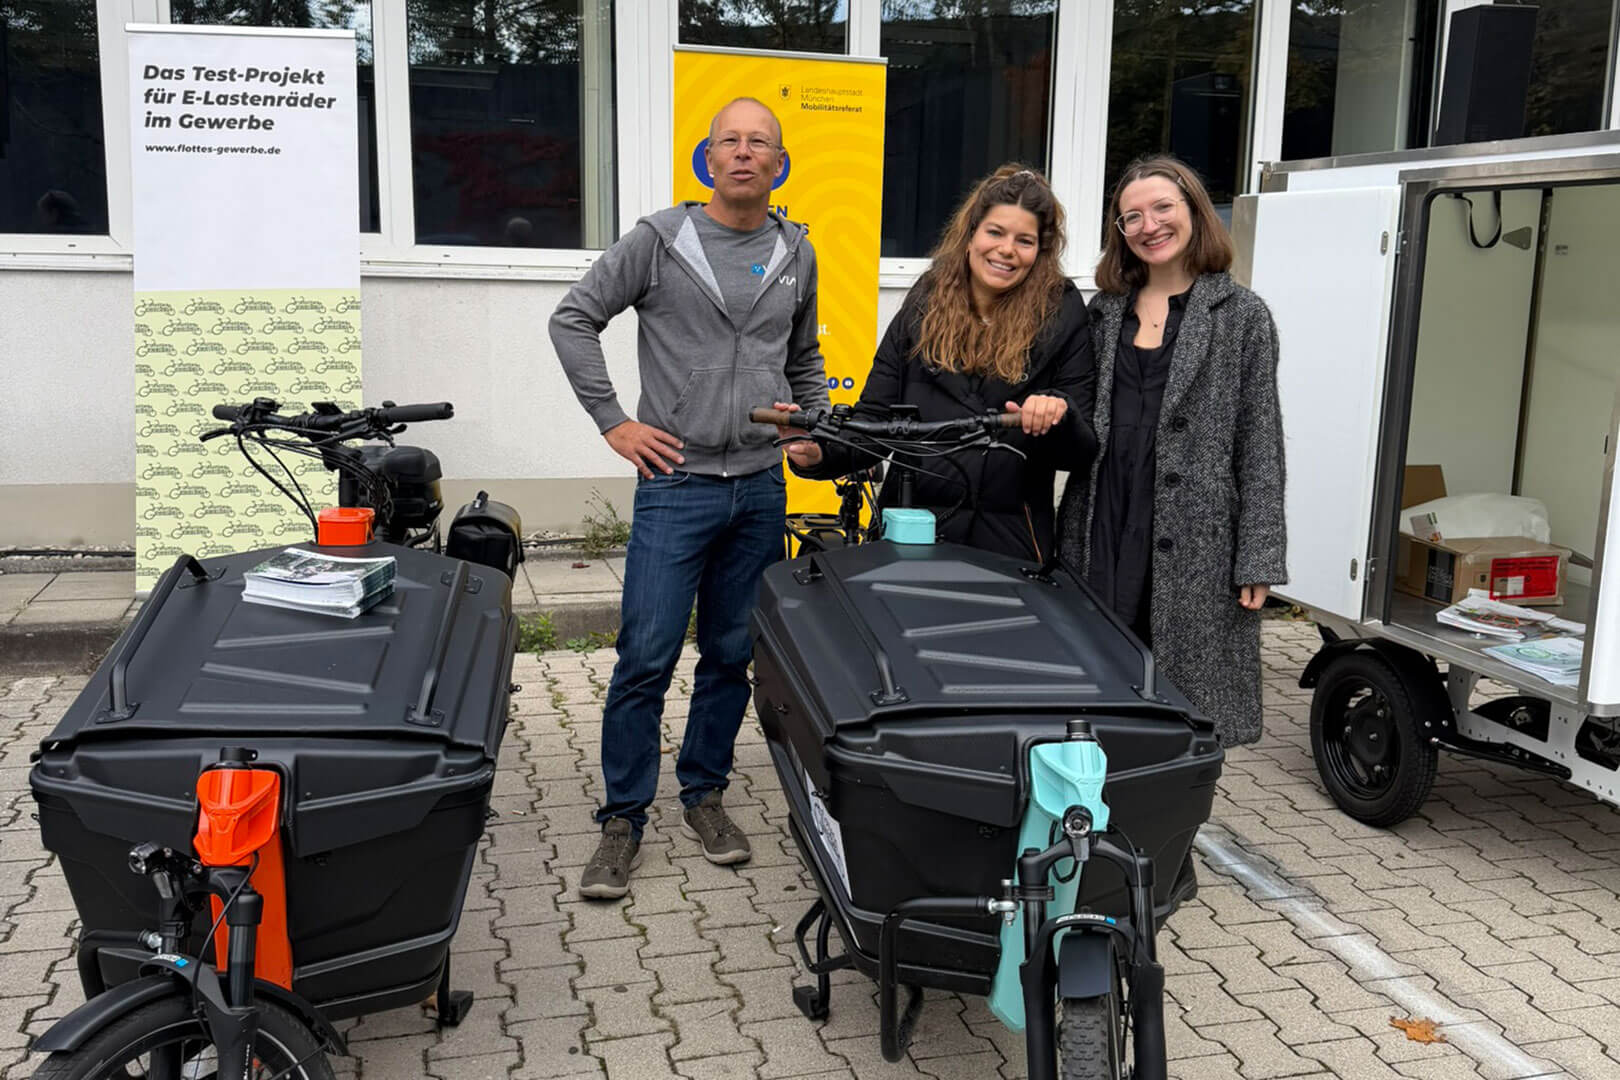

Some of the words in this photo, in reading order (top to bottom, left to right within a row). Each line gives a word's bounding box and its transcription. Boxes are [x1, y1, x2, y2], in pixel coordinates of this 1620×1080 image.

[143, 65, 185, 80] Das
[192, 66, 325, 87] Test-Projekt
[144, 88, 176, 104] für
[182, 90, 336, 109] E-Lastenräder
[801, 94, 835, 103] München
[801, 102, 863, 113] Mobilitätsreferat
[144, 111, 172, 128] im
[178, 113, 275, 130] Gewerbe
[145, 144, 281, 155] www.flottes-gewerbe.de
